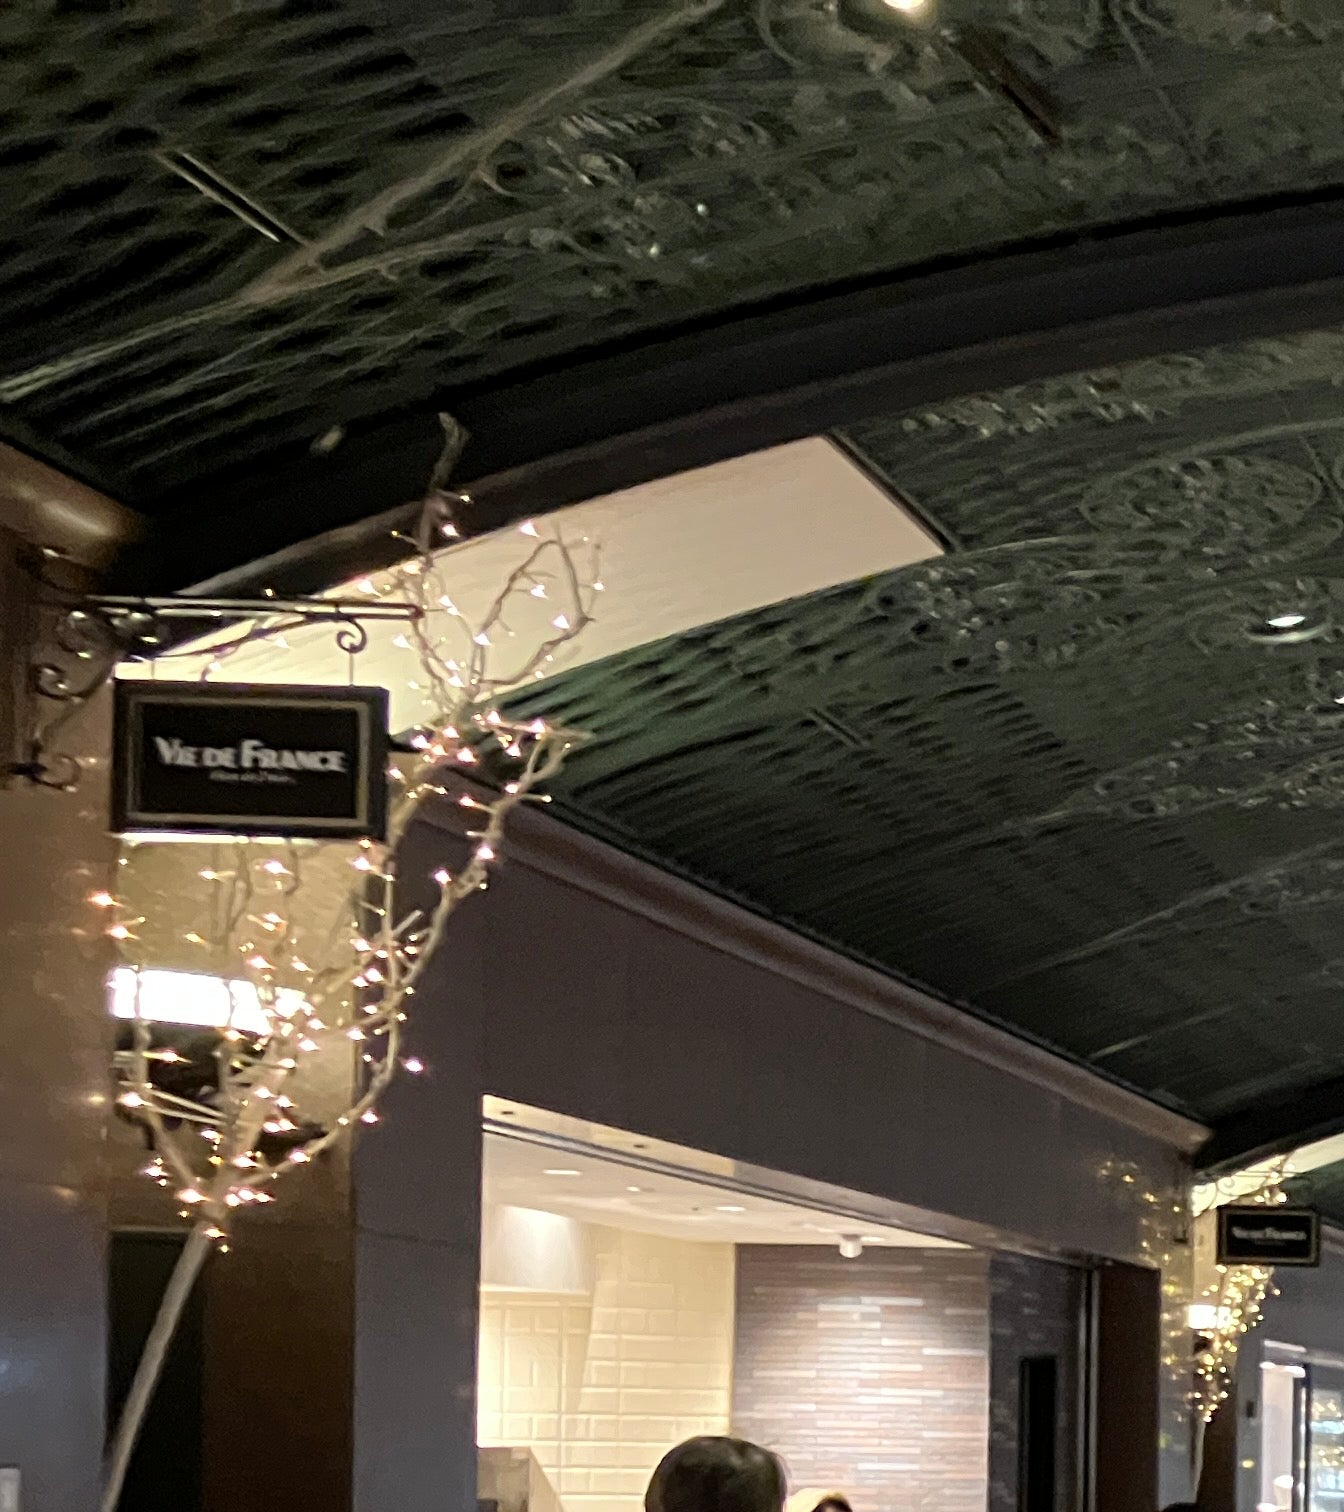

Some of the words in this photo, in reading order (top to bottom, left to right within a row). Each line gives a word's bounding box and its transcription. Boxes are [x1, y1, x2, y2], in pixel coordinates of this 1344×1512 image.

[152, 736, 200, 767] VIE
[202, 747, 238, 769] DE
[240, 739, 348, 773] FRANCE
